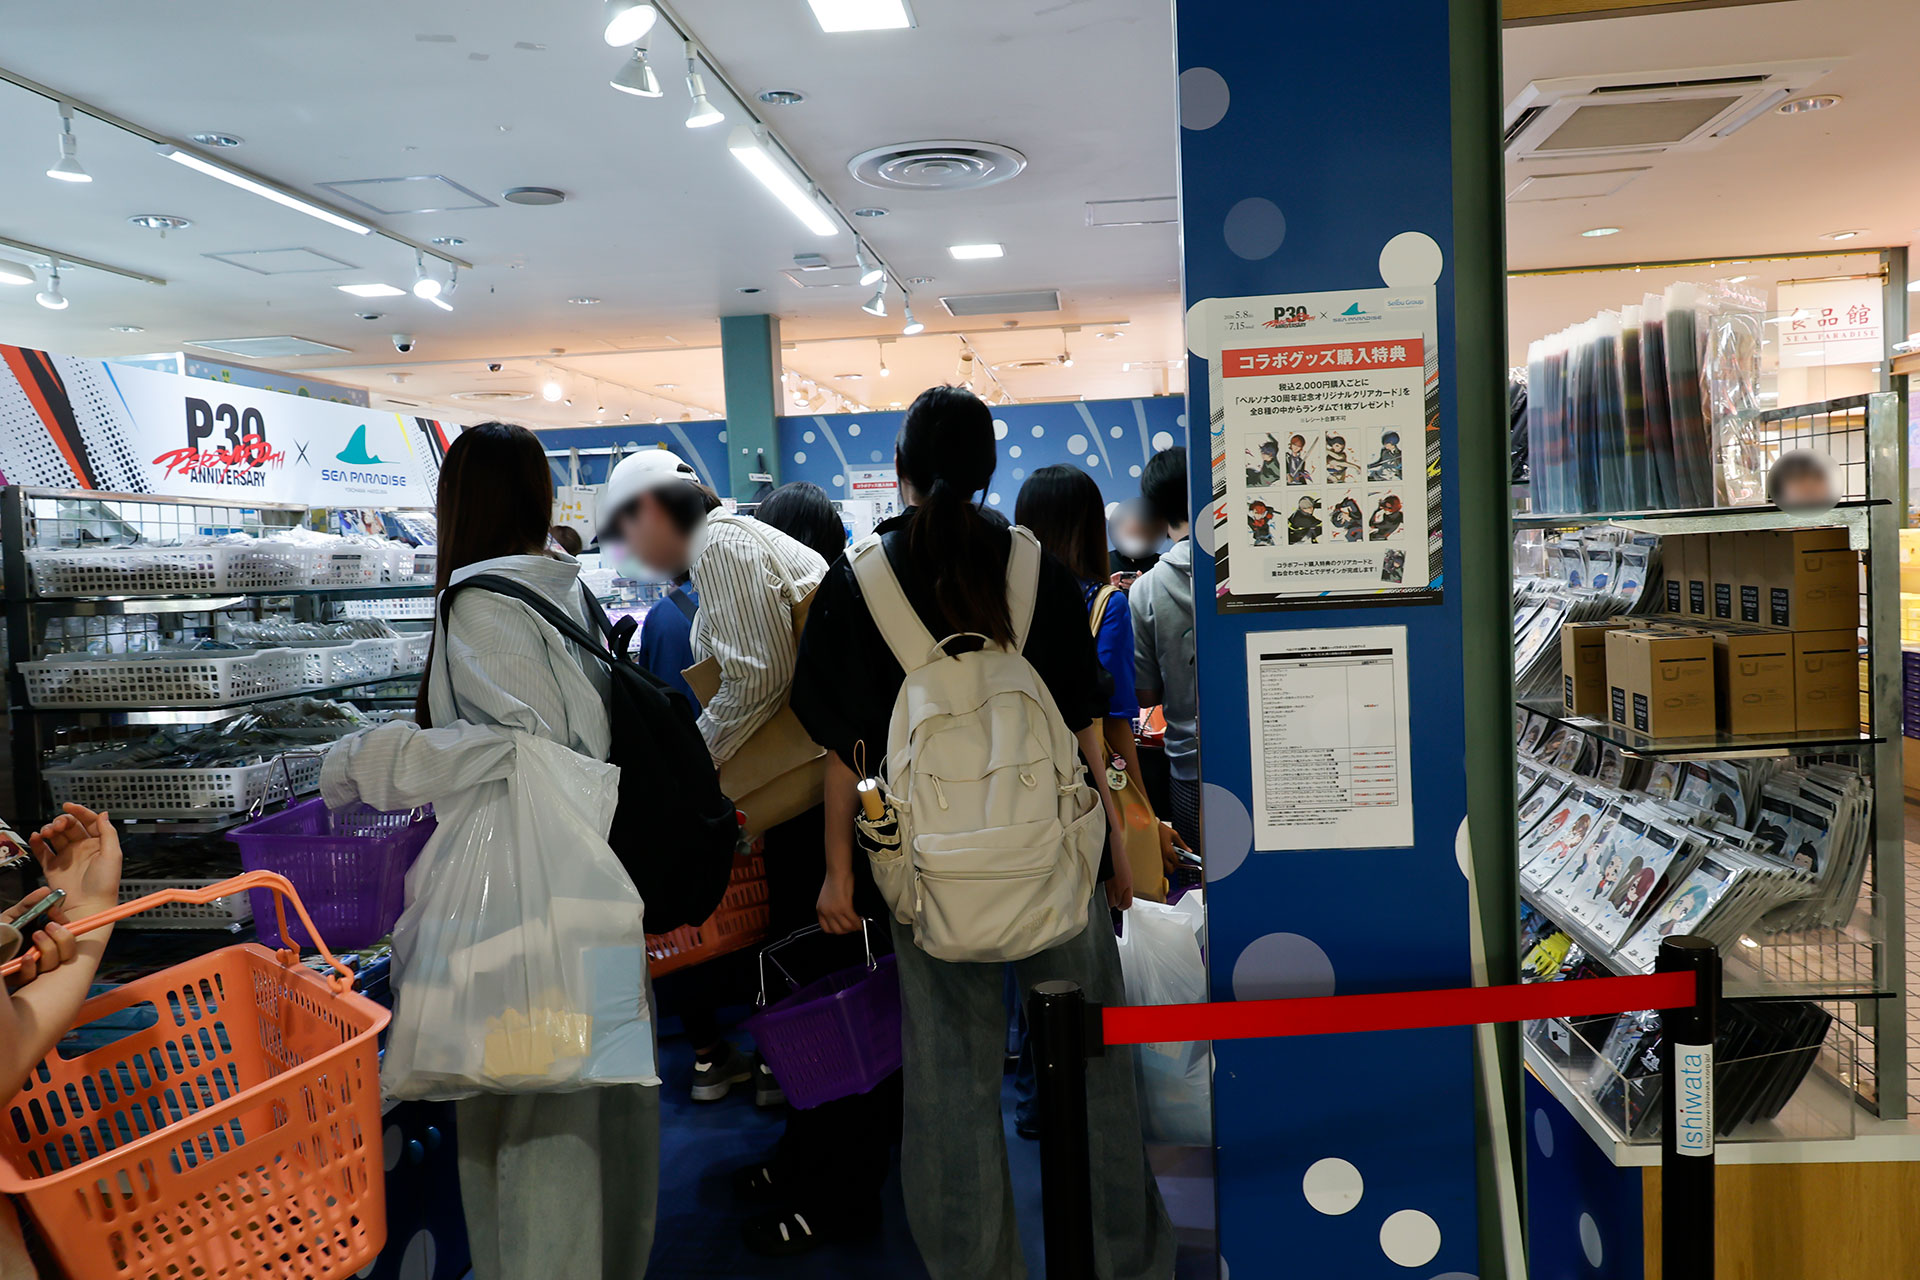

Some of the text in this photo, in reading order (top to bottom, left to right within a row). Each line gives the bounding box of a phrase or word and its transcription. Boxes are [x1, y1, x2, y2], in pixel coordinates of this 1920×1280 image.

[1274, 305, 1307, 322] P30
[1786, 330, 1876, 343] SEA PARADISE
[1239, 345, 1407, 370] コラボグッズ購入特典
[1279, 378, 1369, 391] 税込2,000円購入ごとに
[184, 396, 266, 468] P30
[190, 467, 266, 487] ANNIVERSARY
[321, 469, 406, 486] SEA PARADISE
[1680, 1054, 1703, 1149] Ishiwata
